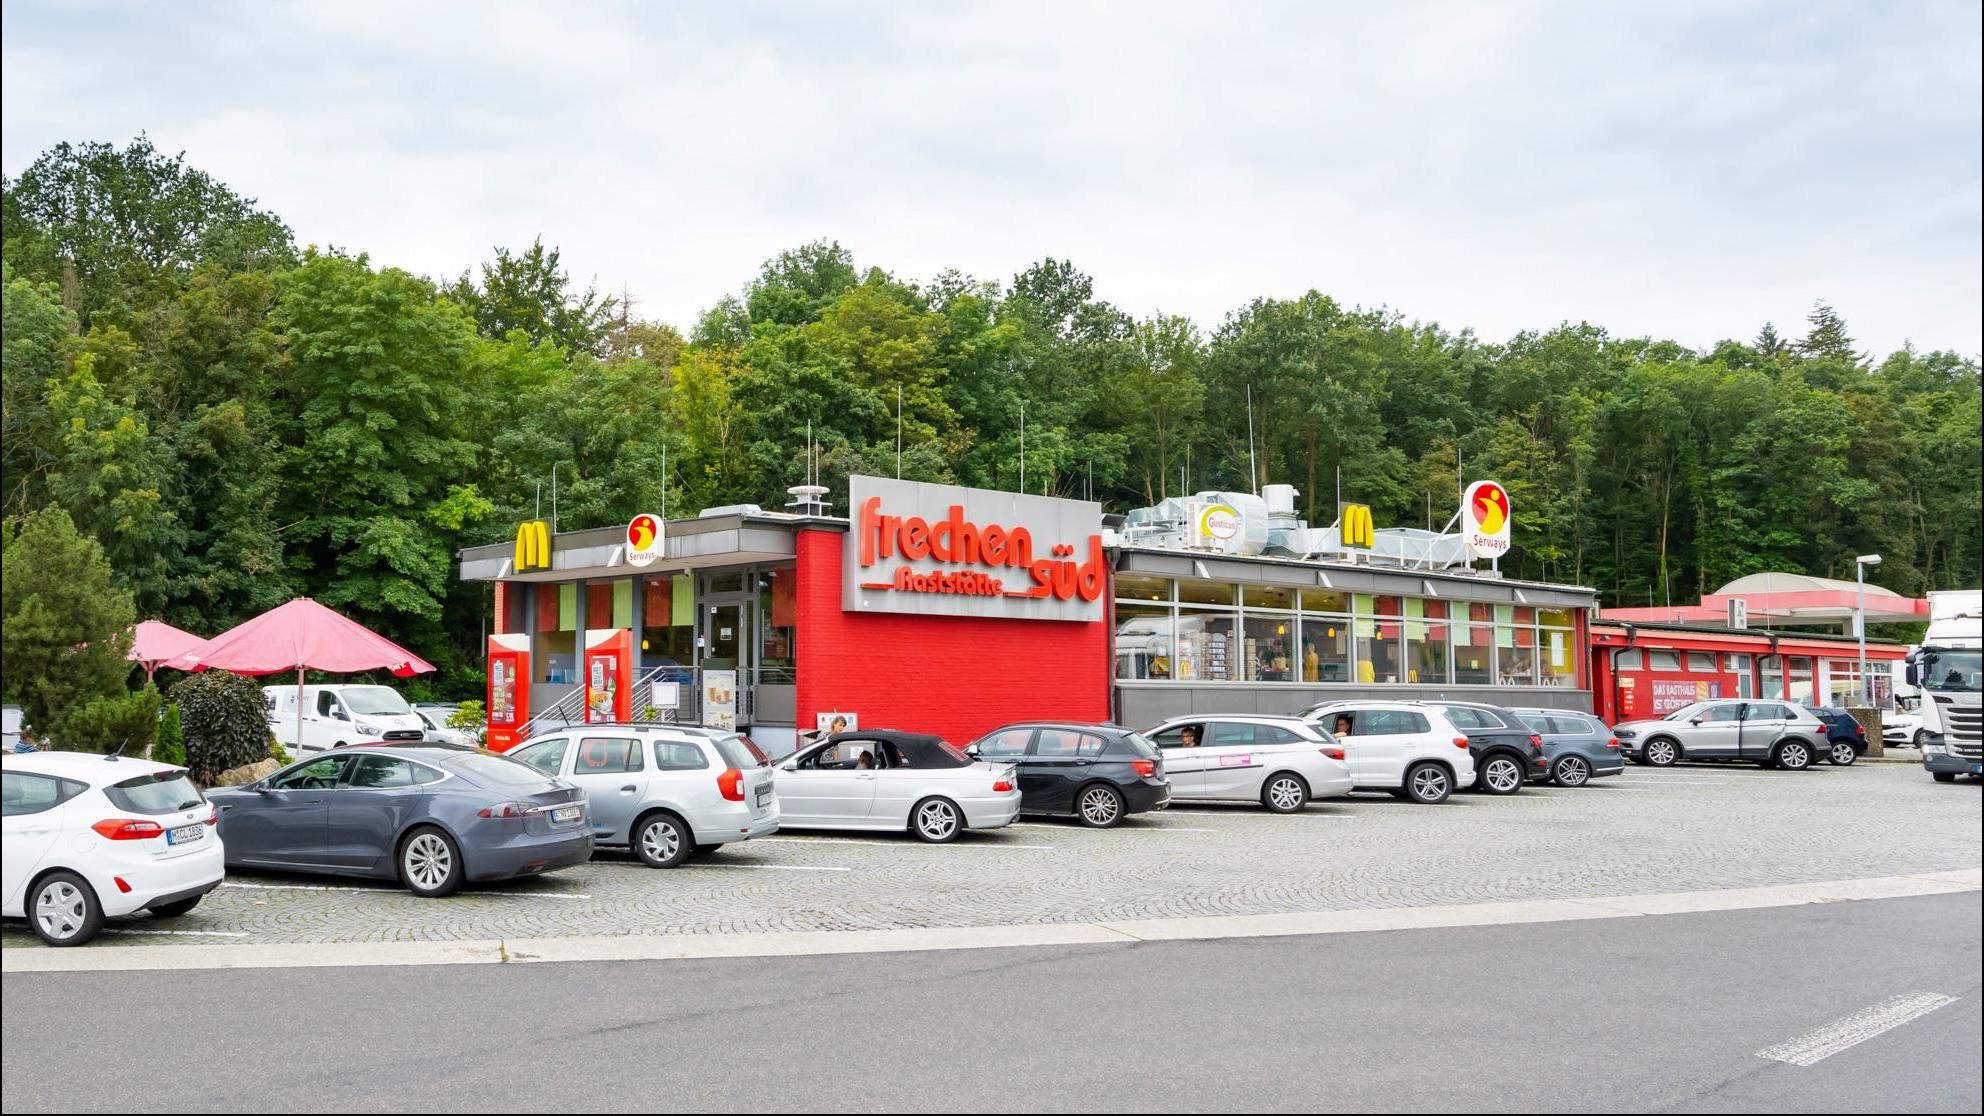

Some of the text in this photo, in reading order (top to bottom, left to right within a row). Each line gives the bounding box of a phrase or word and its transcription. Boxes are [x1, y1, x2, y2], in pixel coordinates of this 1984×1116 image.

[860, 496, 1104, 601] frechen süd
[1473, 534, 1507, 551] Serways
[629, 552, 657, 562] Serways
[894, 565, 1004, 596] Raststätte
